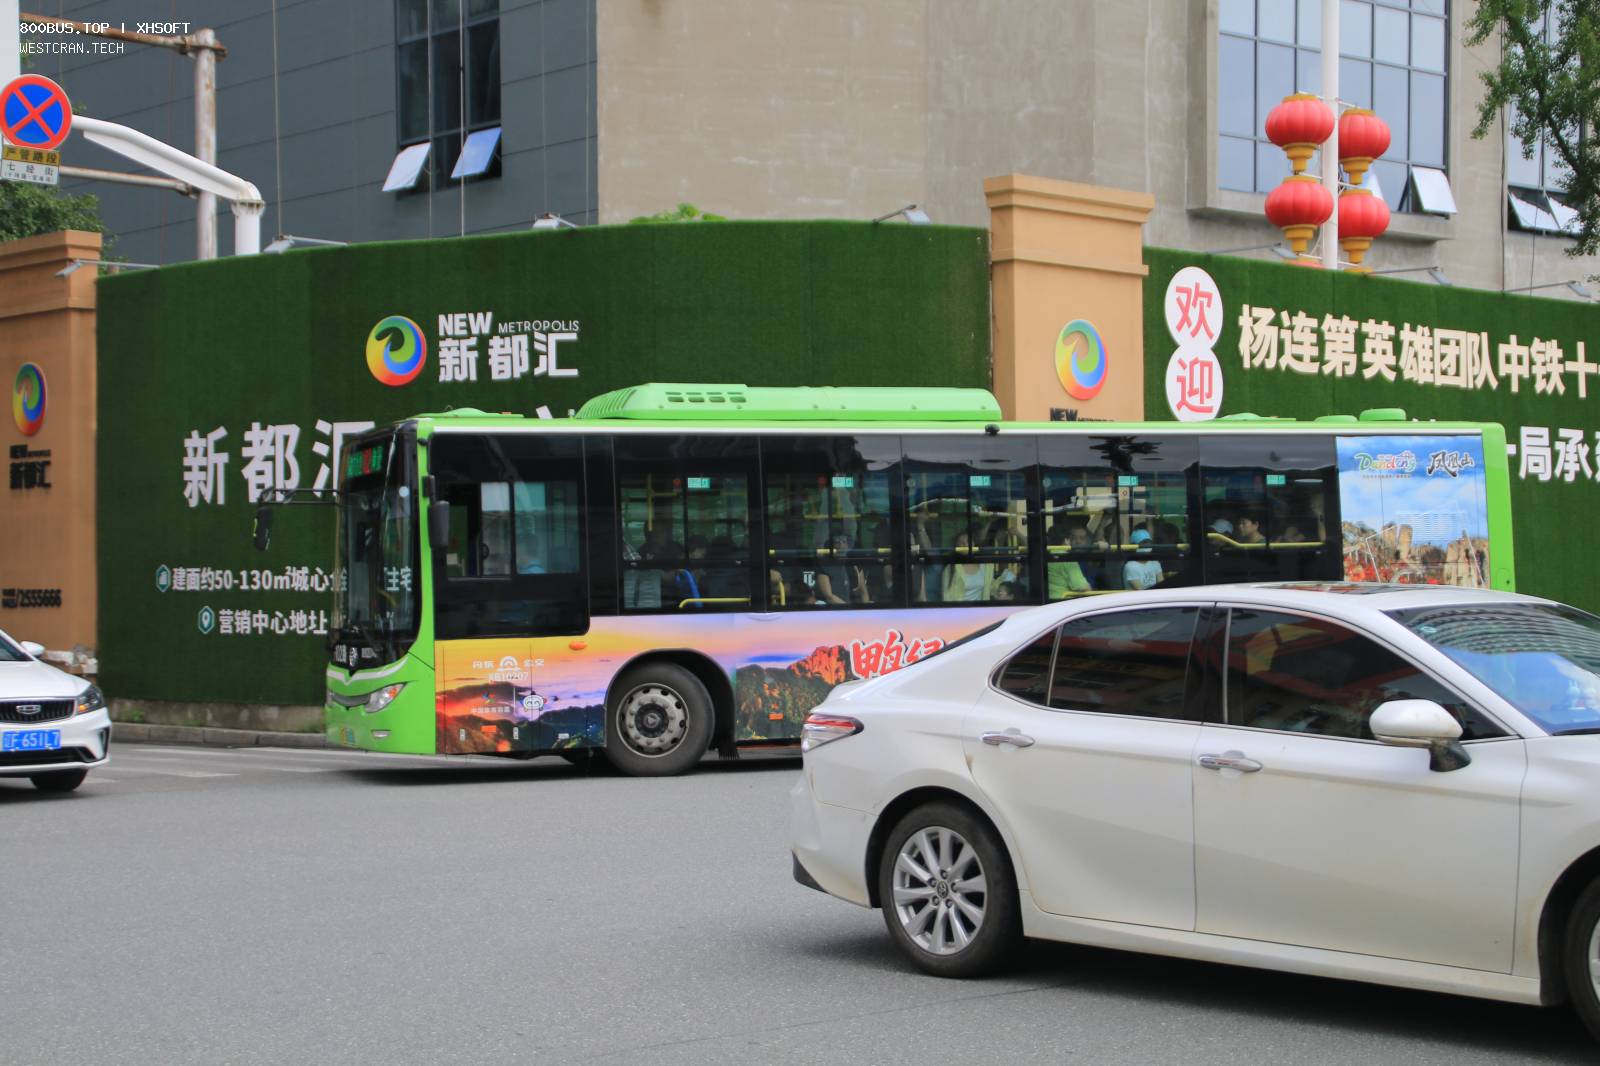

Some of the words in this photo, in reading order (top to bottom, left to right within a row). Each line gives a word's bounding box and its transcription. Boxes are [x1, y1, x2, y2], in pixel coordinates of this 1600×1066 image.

[438, 312, 493, 336] NEW
[498, 320, 580, 334] METROPOLIS
[1175, 281, 1215, 414] 欢迎
[438, 332, 579, 383] 新都汇
[1238, 304, 1600, 398] 杨连第英雄团队中铁十
[1507, 426, 1600, 482] 局承
[218, 609, 329, 636] 营销中心地址
